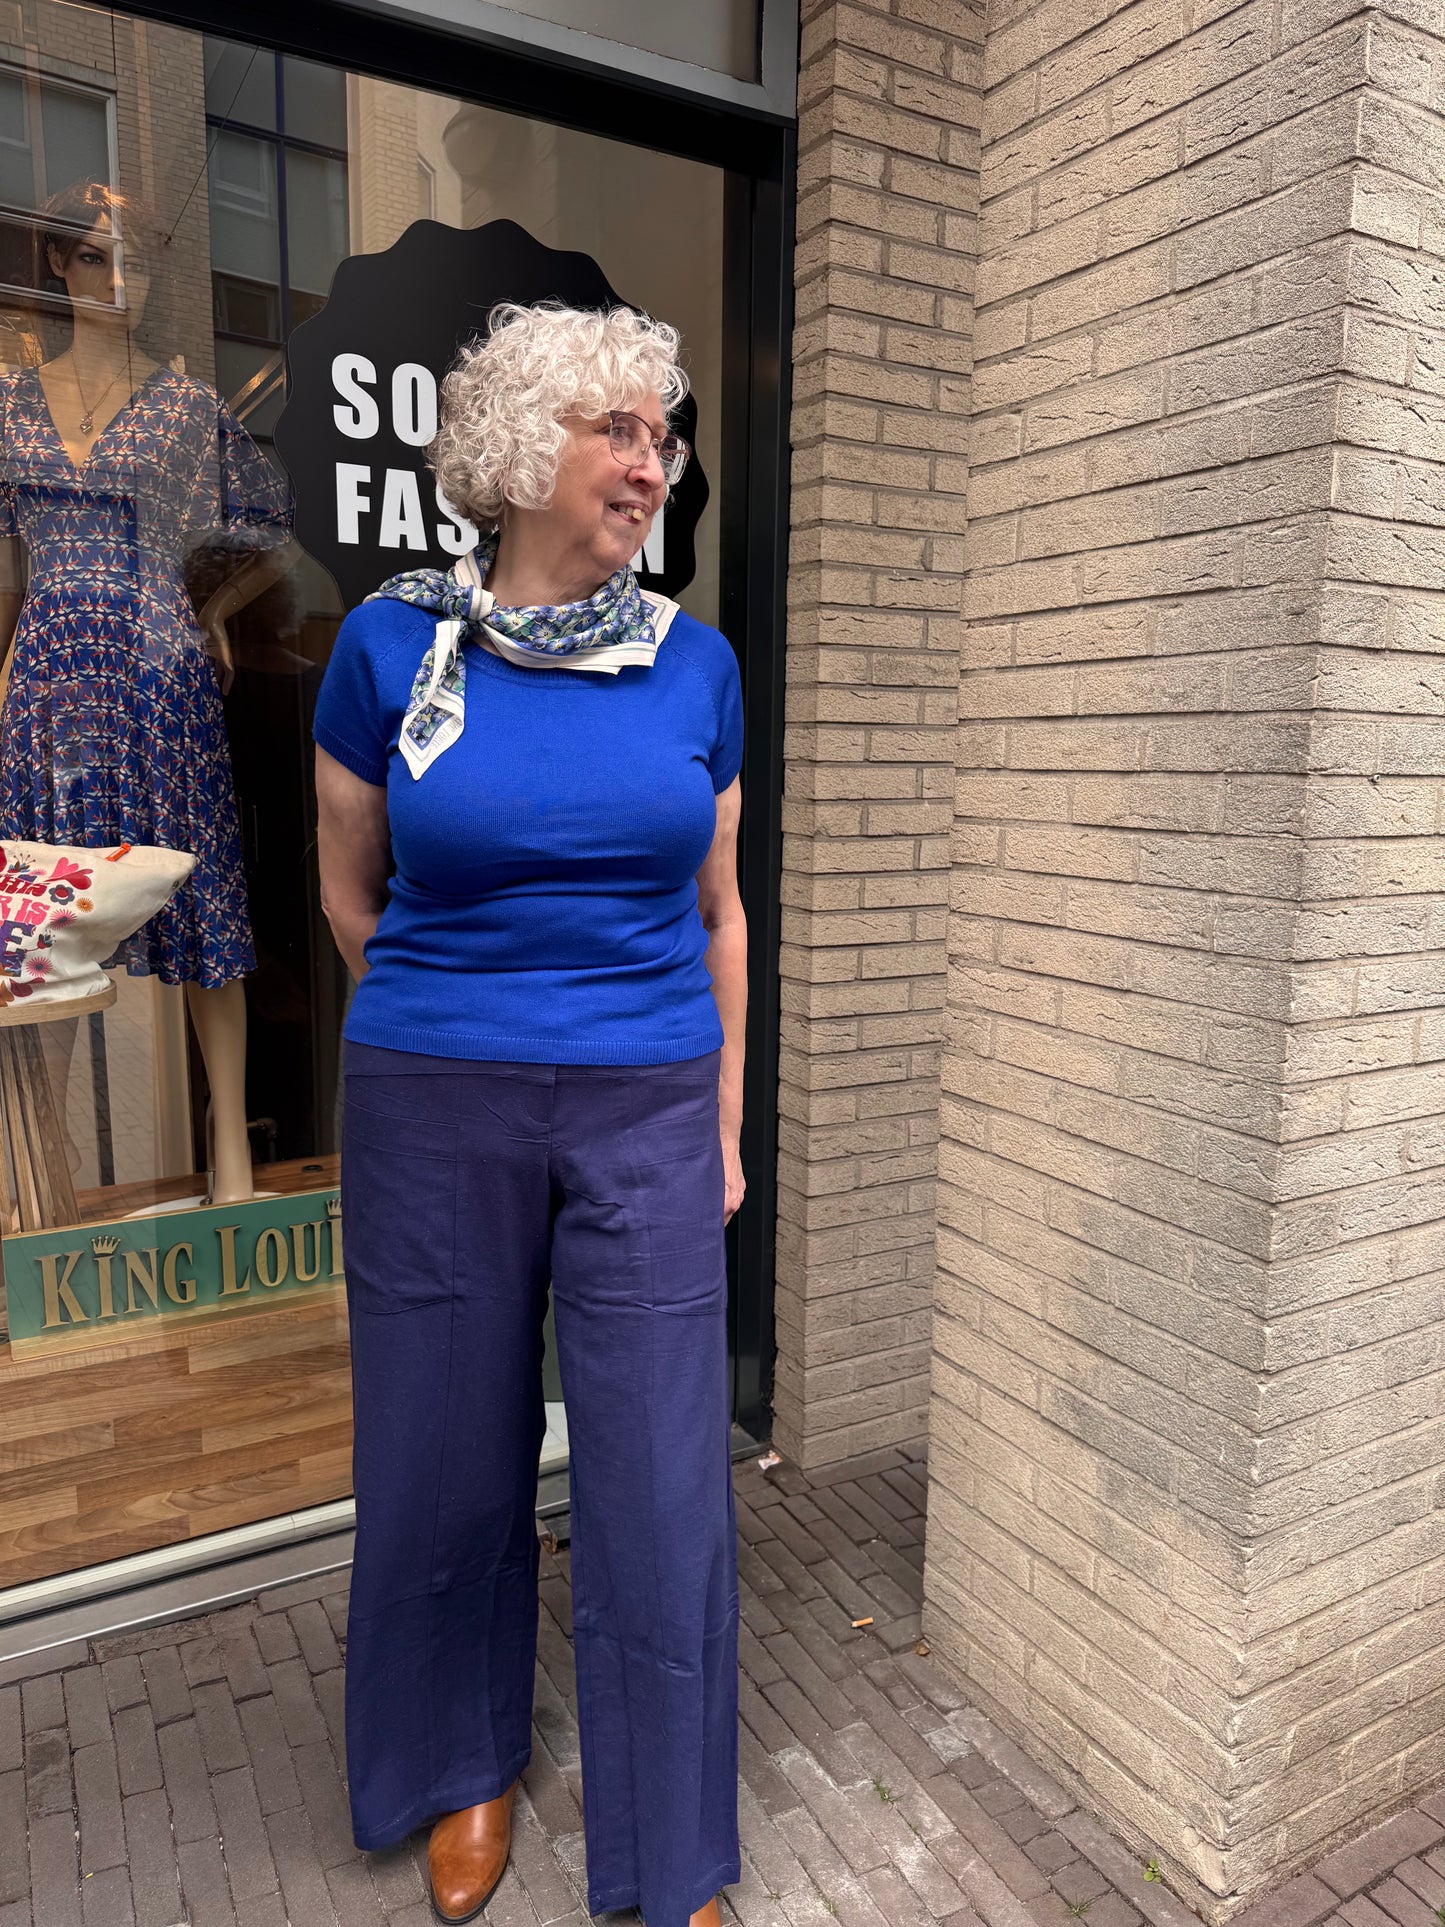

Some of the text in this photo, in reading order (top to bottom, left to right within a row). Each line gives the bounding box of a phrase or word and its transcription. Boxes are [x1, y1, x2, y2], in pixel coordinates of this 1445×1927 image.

[331, 352, 438, 448] SO
[14, 898, 50, 925] IS
[34, 1217, 345, 1330] KING LOUI
